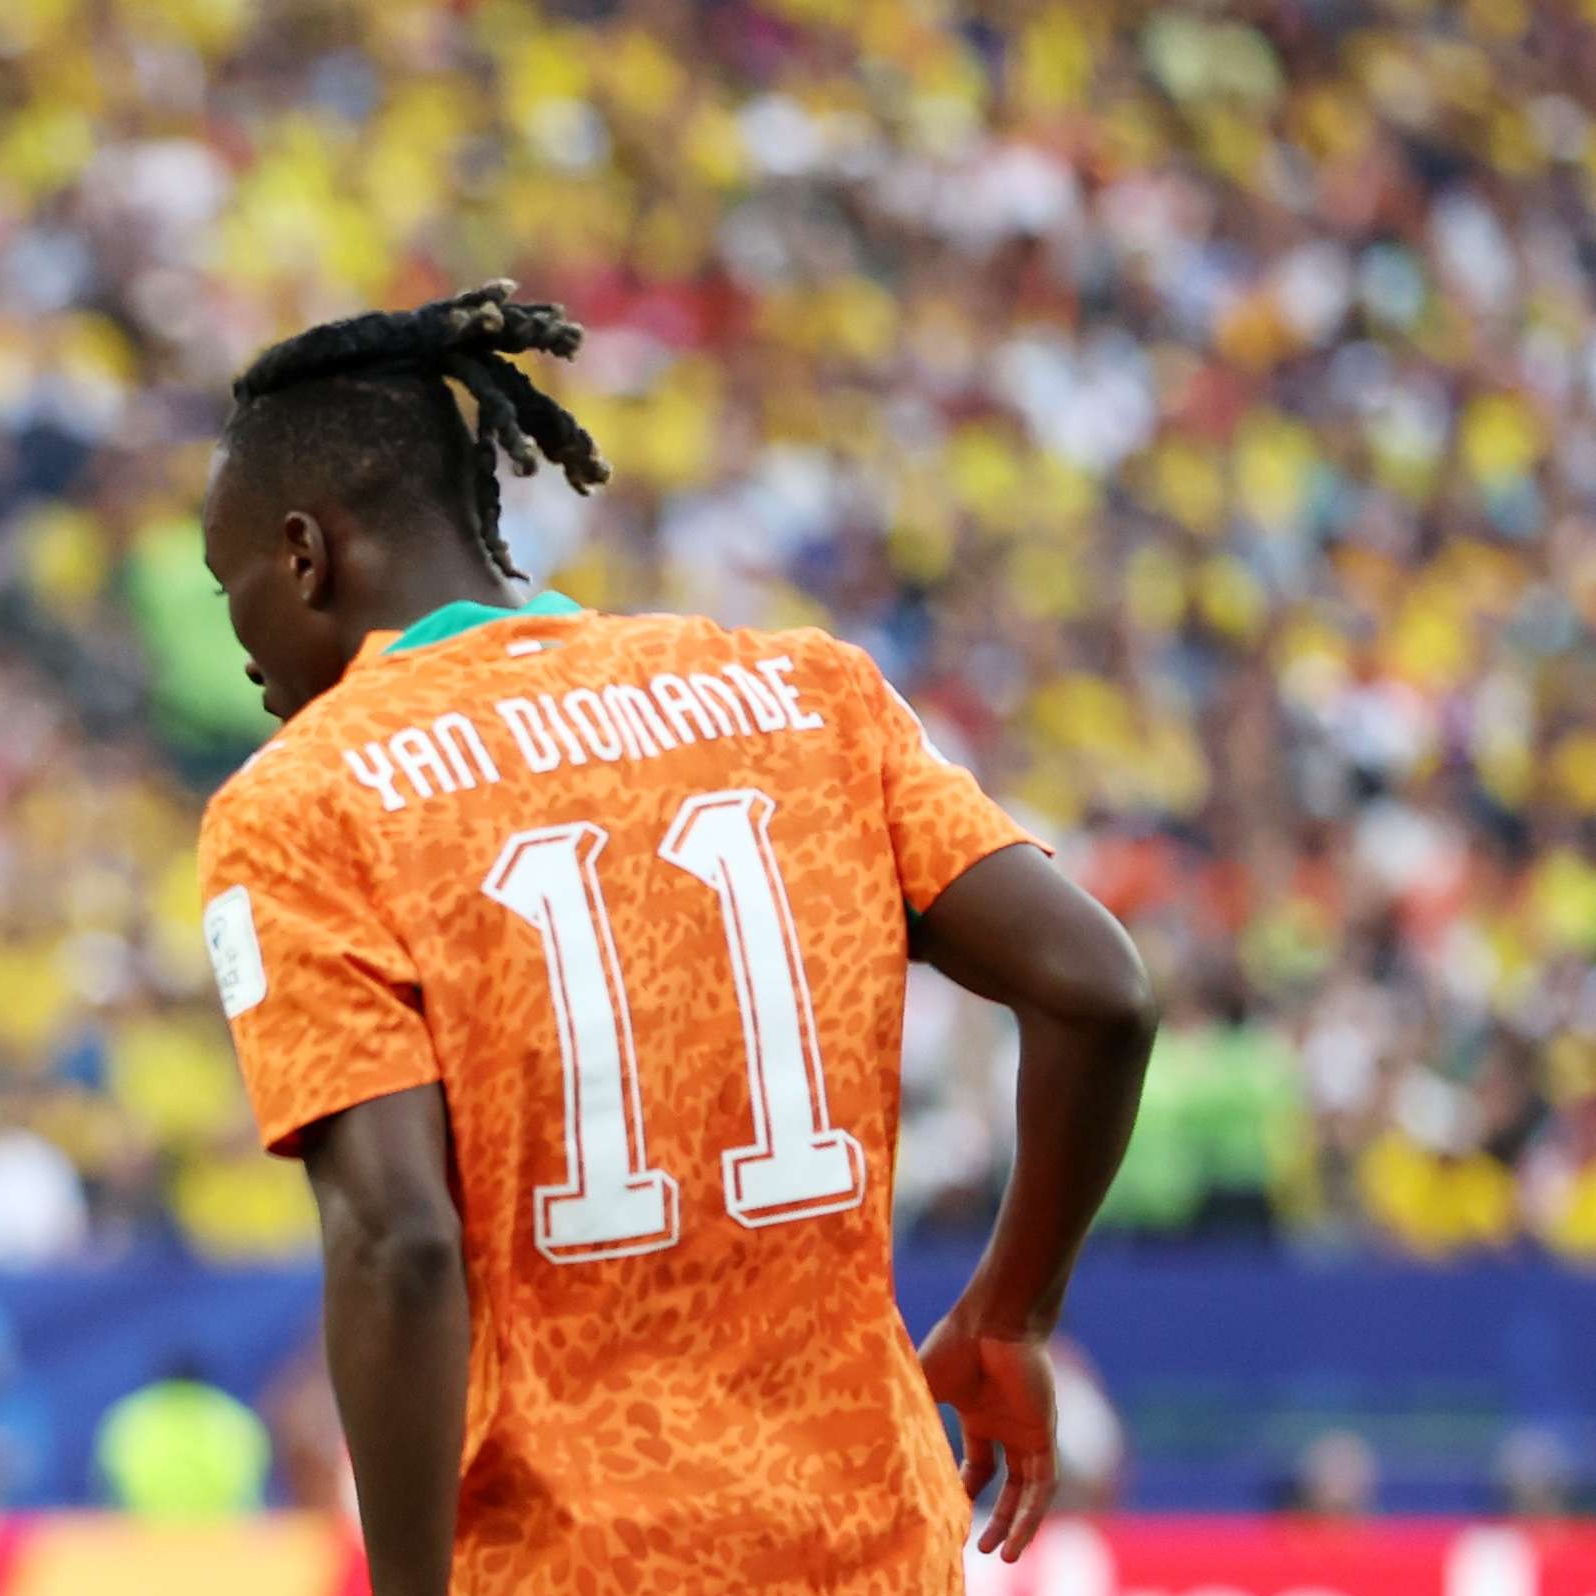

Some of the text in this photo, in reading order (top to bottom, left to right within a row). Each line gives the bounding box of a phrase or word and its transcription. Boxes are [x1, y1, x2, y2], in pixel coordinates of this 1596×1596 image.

[344, 655, 825, 812] YAN DIOMANDE
[482, 788, 866, 1265] 11
